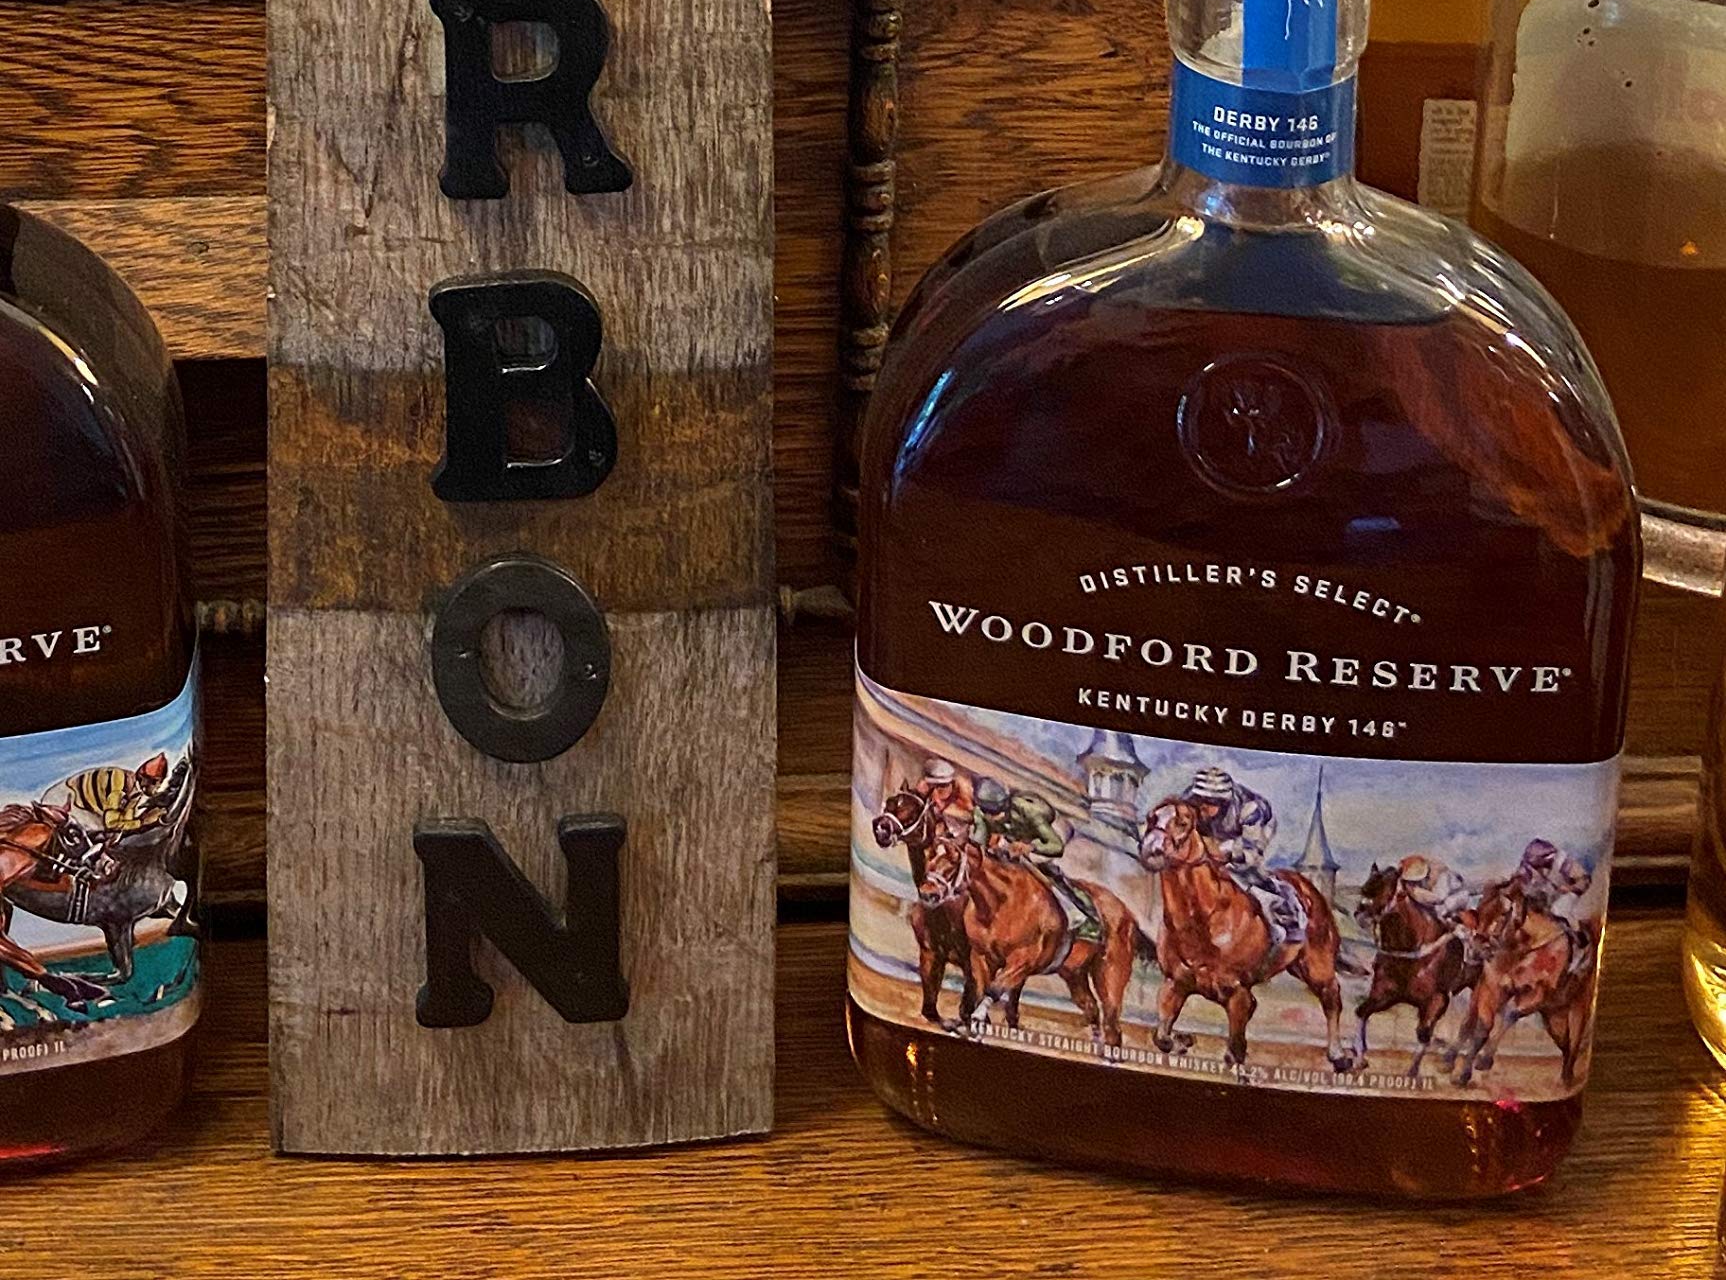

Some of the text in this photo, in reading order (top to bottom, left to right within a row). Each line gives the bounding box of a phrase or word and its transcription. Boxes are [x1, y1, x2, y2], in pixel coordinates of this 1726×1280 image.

[1213, 106, 1318, 132] DERBY 146
[1192, 120, 1211, 136] THE
[1213, 130, 1266, 149] OFFICIAL
[1270, 136, 1324, 149] BOURBON
[1201, 142, 1222, 158] THE
[1225, 150, 1288, 166] KENTUCKY
[1079, 563, 1277, 593] DISTILLER'S
[928, 600, 1259, 677] WOODFORD
[1078, 687, 1228, 724] KENTUCKY
[1242, 710, 1335, 734] DERBY
[970, 1020, 1033, 1043] KENTUCKY
[1038, 1032, 1099, 1054] STRAIGHT
[1104, 1044, 1163, 1065] BOURBON
[1168, 1056, 1224, 1073] WHISKEY
